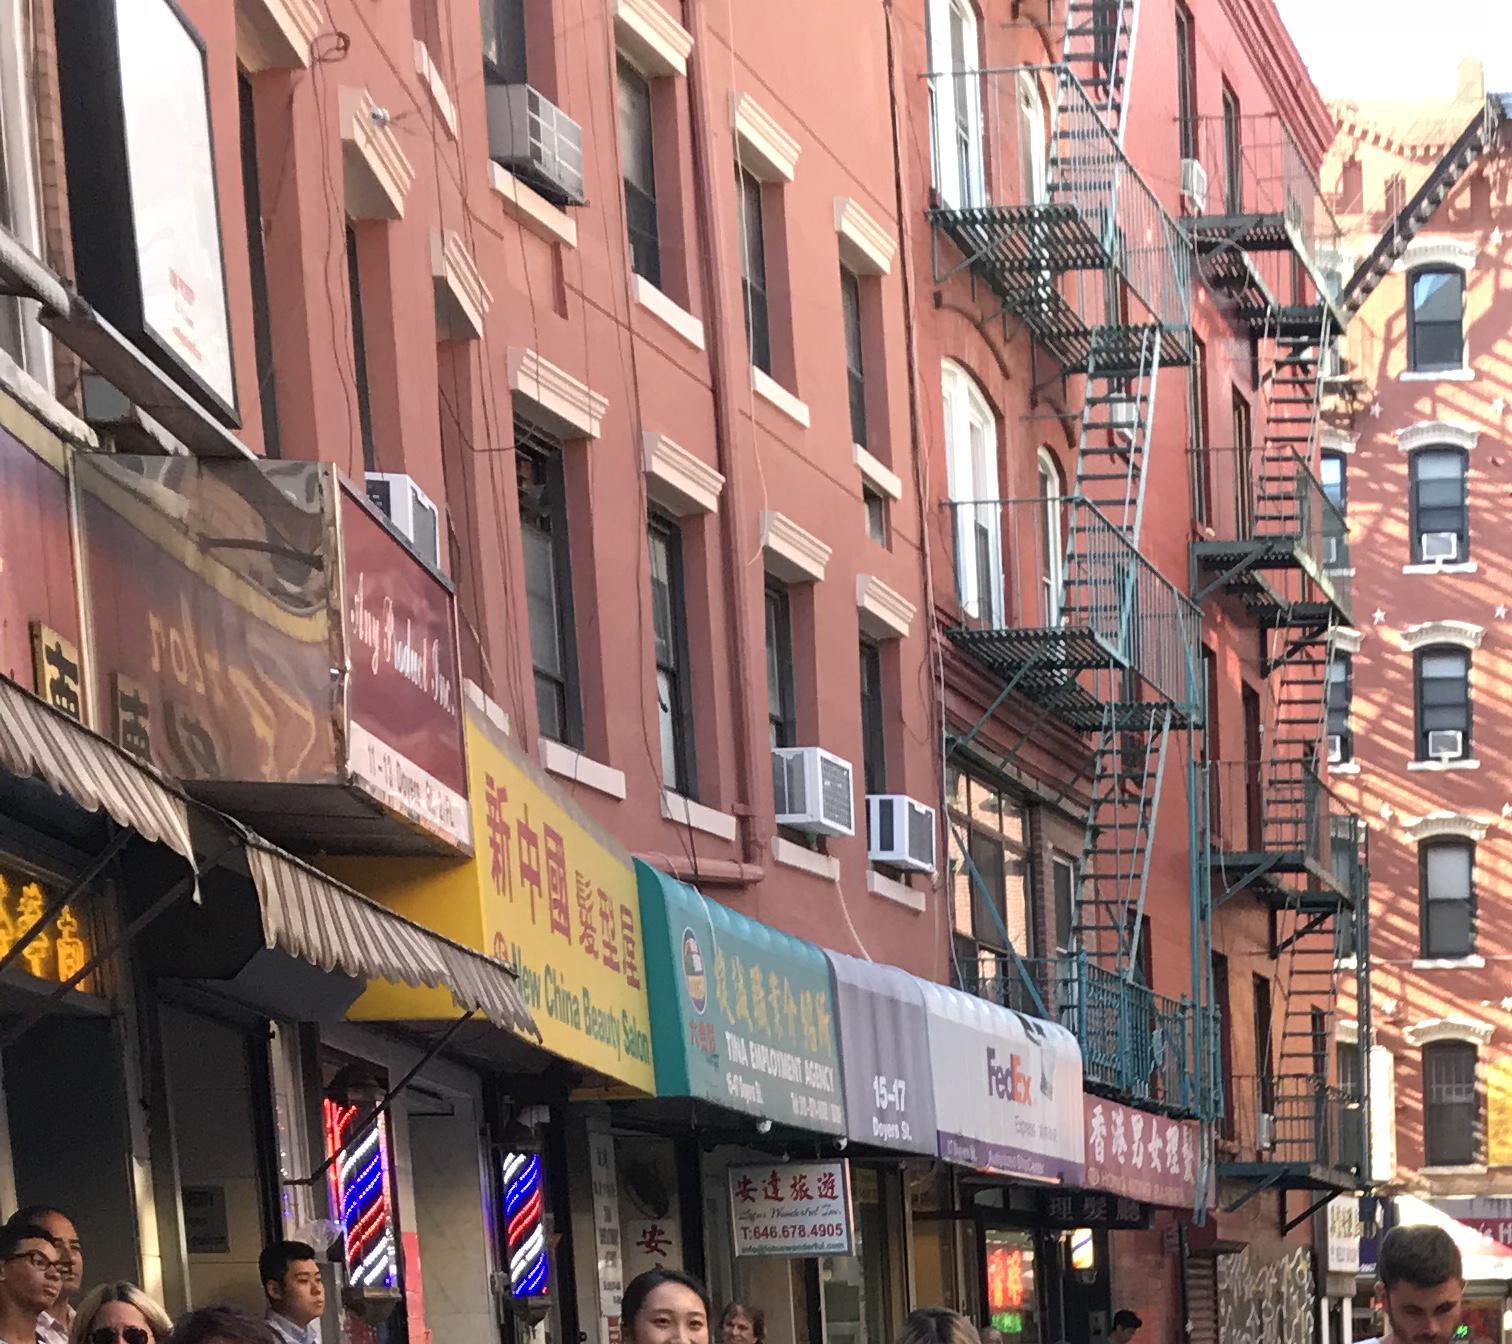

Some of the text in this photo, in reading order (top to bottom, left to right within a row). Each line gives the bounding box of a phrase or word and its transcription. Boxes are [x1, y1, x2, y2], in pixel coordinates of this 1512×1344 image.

[510, 941, 541, 1011] New
[544, 963, 581, 1030] China
[582, 986, 622, 1062] Beauty
[621, 1008, 650, 1064] Salon
[724, 1031, 749, 1067] TINA
[749, 1040, 802, 1083] EMPLOYMENT
[804, 1060, 835, 1093] AGENCY
[986, 1047, 1032, 1105] FedEx
[872, 1075, 906, 1112] 15-17
[872, 1116, 912, 1142] Doyers St.
[735, 1168, 839, 1202] 安達旅遊
[741, 1223, 843, 1241] T:646.678.4905
